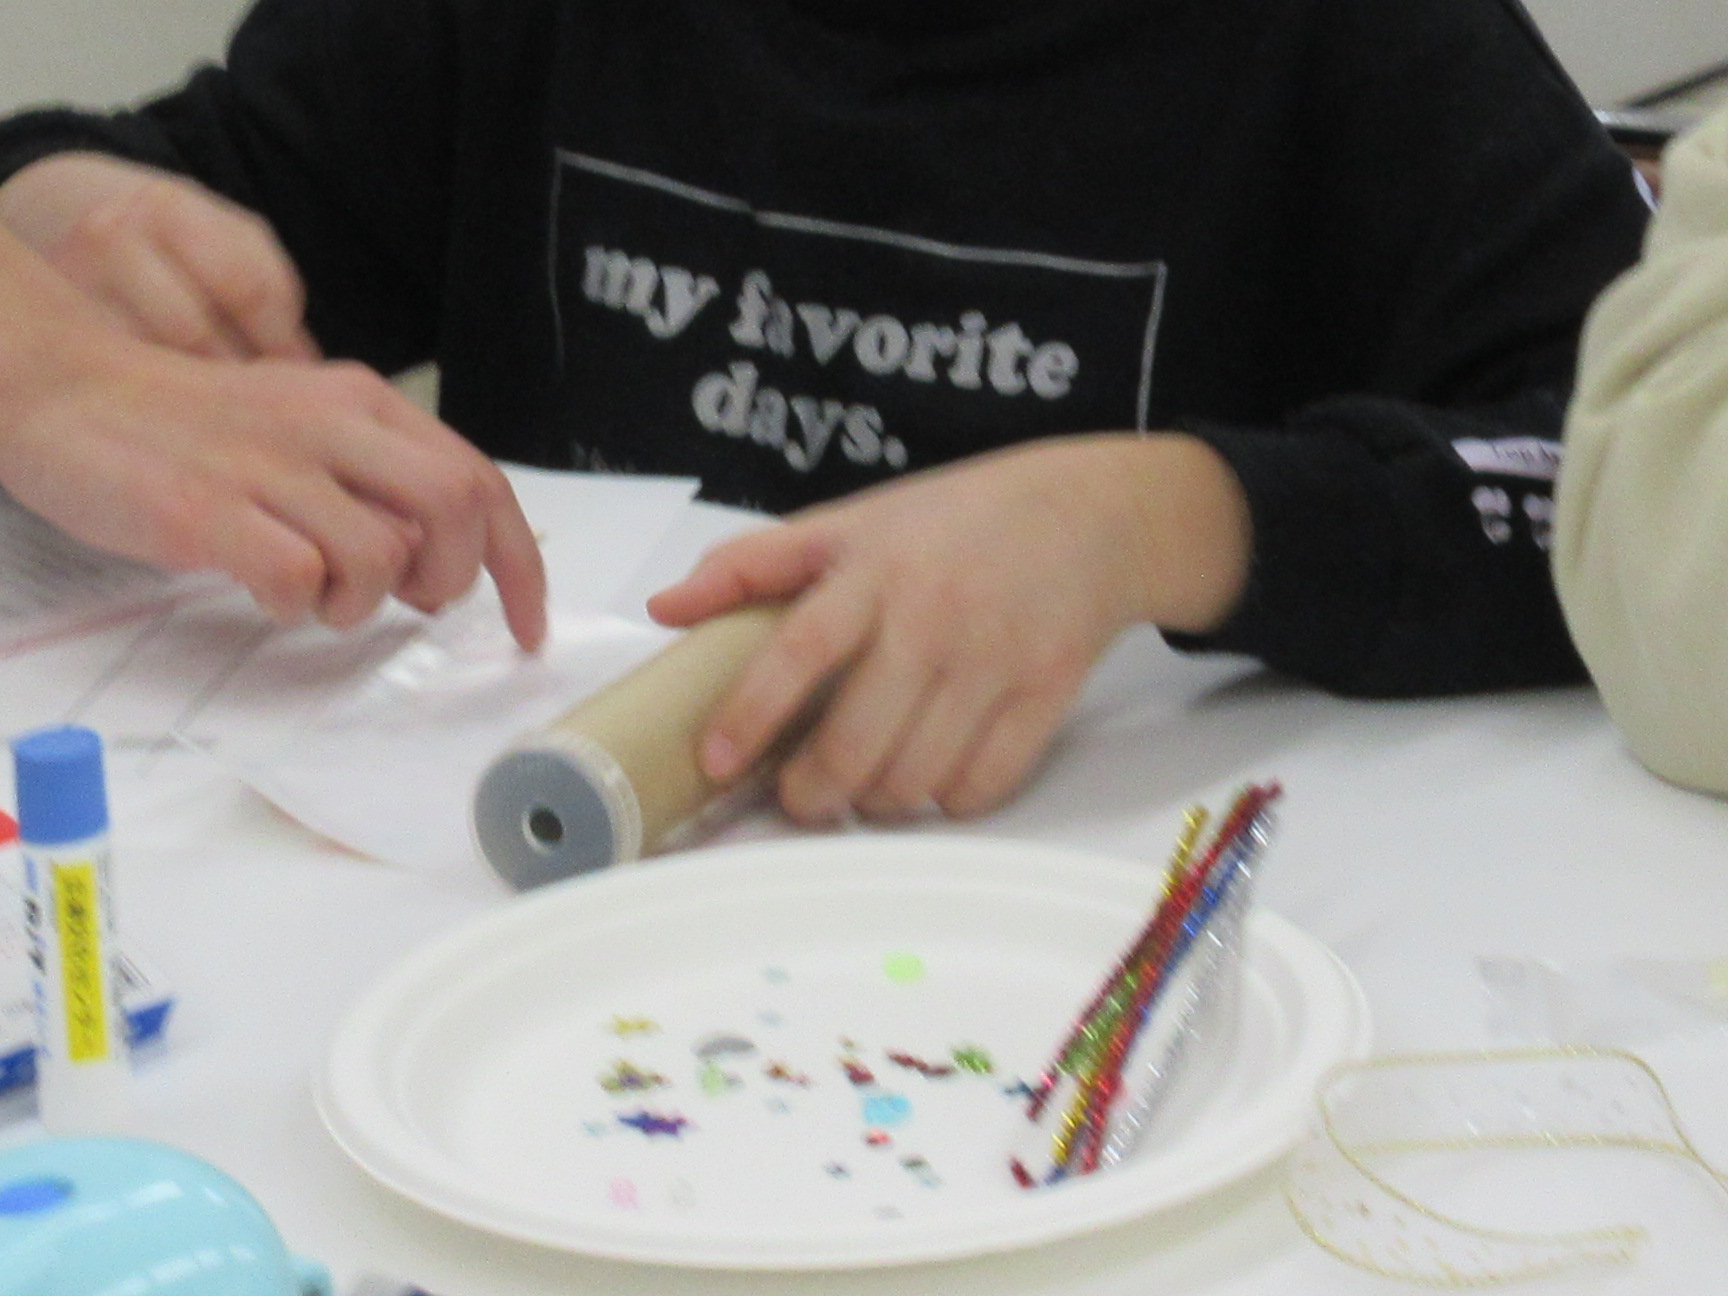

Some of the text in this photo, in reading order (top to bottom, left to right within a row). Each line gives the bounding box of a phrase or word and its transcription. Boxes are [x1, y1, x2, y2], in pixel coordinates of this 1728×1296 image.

[581, 243, 1080, 401] my favorite
[691, 359, 909, 473] days.
